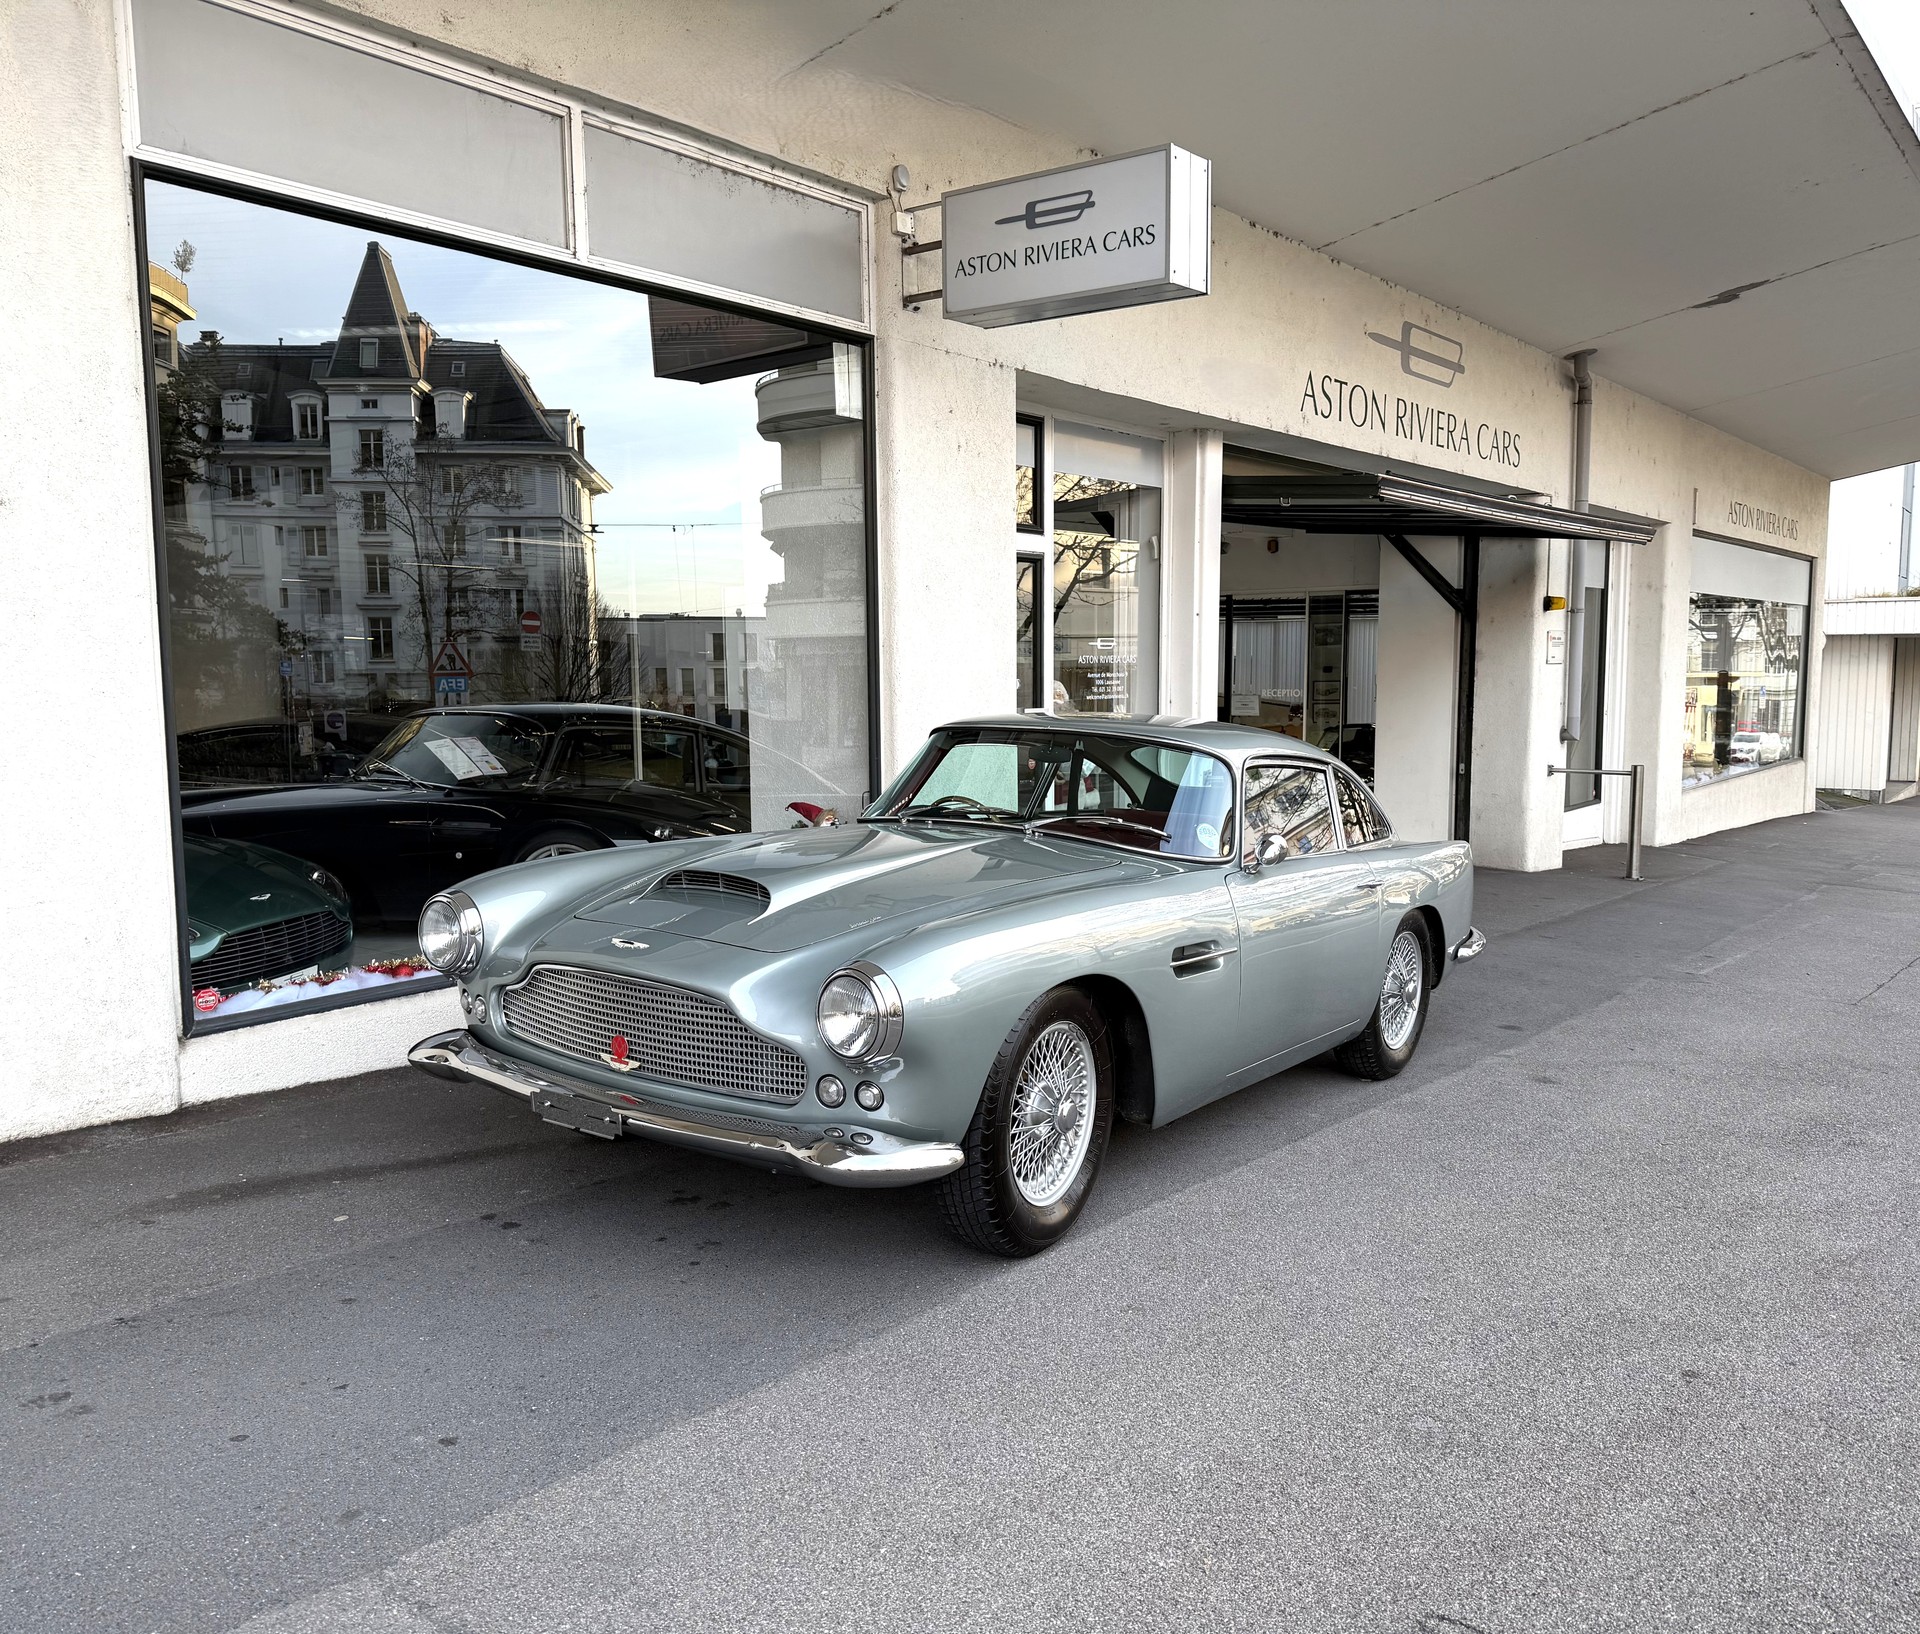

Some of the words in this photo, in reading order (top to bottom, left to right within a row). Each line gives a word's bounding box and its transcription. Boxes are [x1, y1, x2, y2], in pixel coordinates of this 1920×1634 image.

[954, 249, 1017, 279] ASTON
[1024, 235, 1098, 267] RIVIERA
[1103, 223, 1156, 252] CARS
[1300, 370, 1387, 434] ASTON
[1395, 397, 1471, 456] RIVIERA
[1477, 423, 1521, 468] CARS
[1727, 500, 1755, 529] ASTON
[1756, 508, 1781, 537] RIVIERA
[1782, 516, 1799, 541] CARS
[1078, 655, 1098, 664] ASTON
[1099, 654, 1121, 664] RIVIERA
[1122, 654, 1137, 664] CARS
[1261, 688, 1303, 698] RECEPTIO
